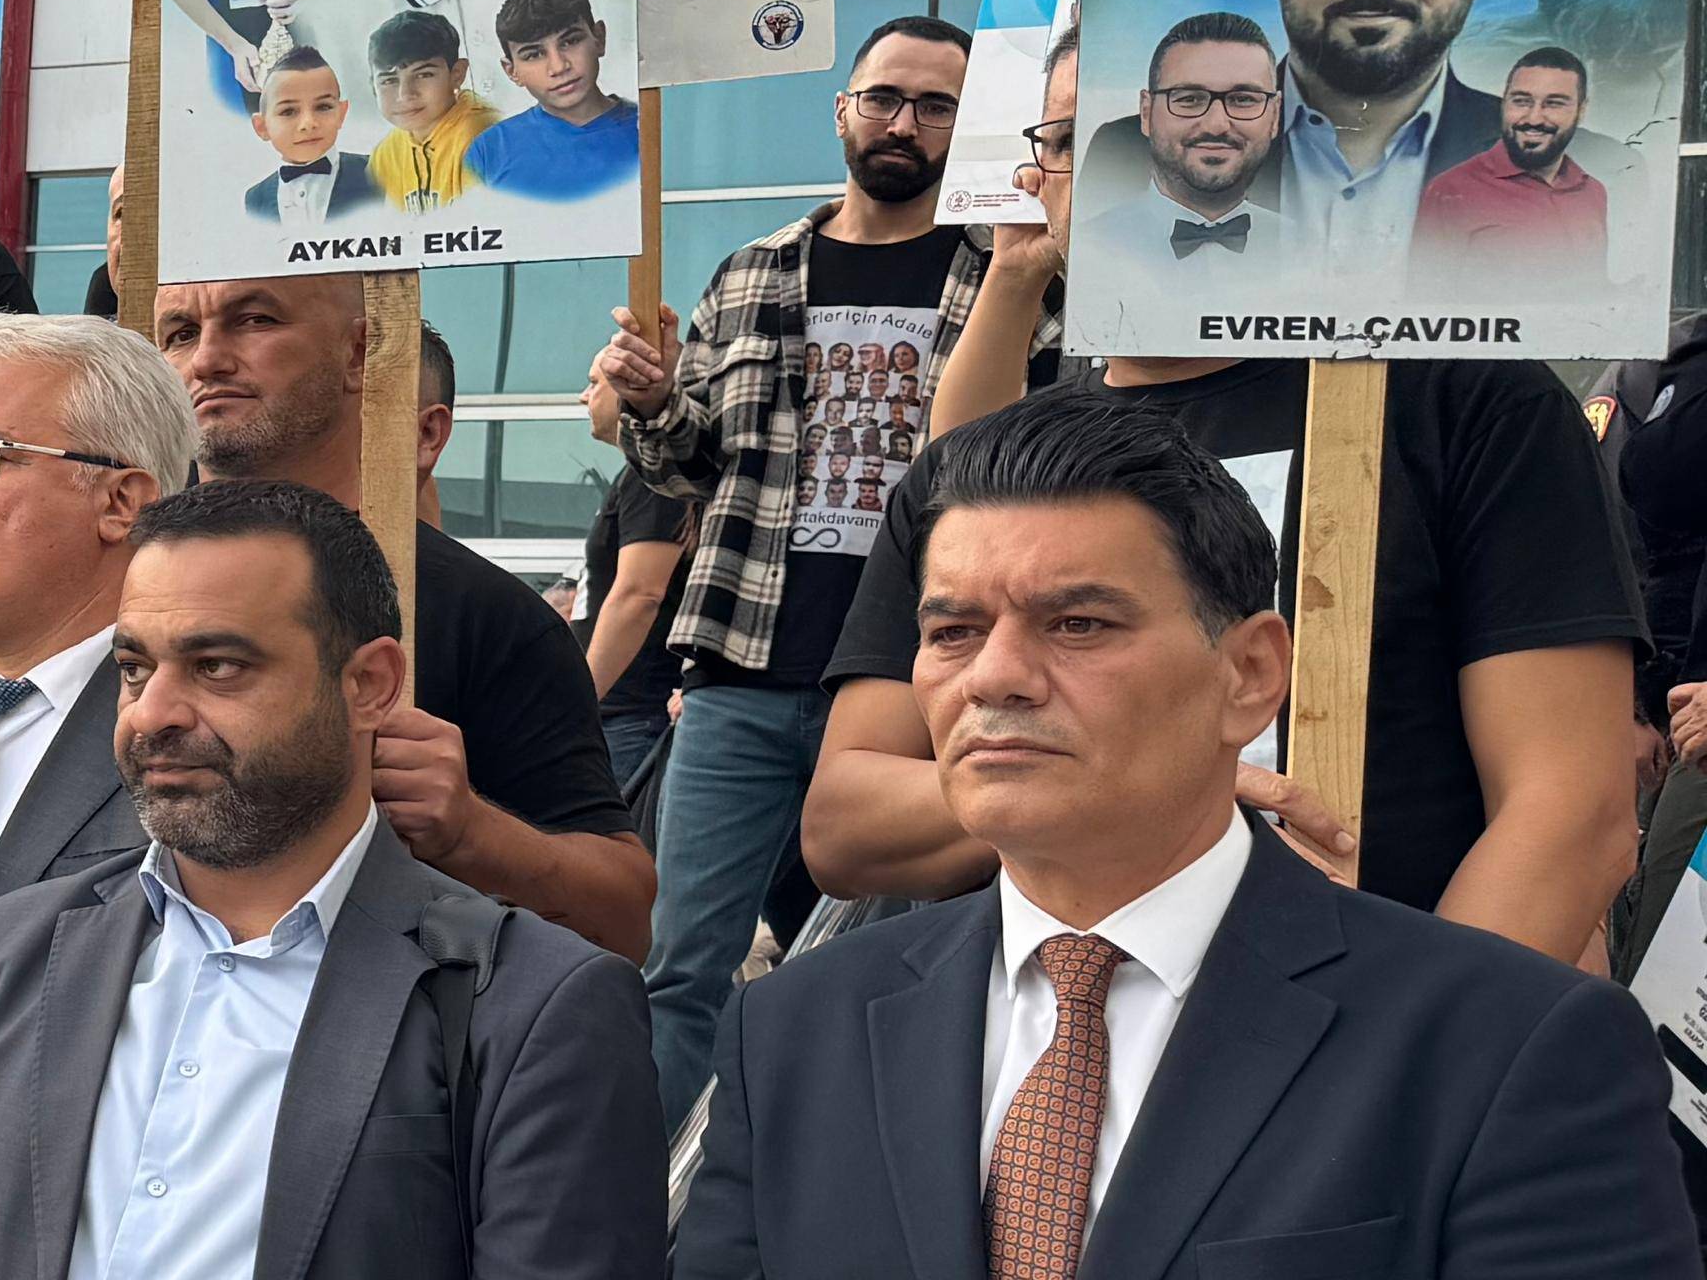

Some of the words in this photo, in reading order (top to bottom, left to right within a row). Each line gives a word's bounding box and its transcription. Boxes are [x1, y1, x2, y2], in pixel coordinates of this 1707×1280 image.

[287, 235, 402, 263] AYKAN
[423, 225, 503, 254] EKİZ
[881, 312, 934, 340] Adale
[1199, 315, 1336, 341] EVREN
[1364, 316, 1522, 349] ÇAVDIR
